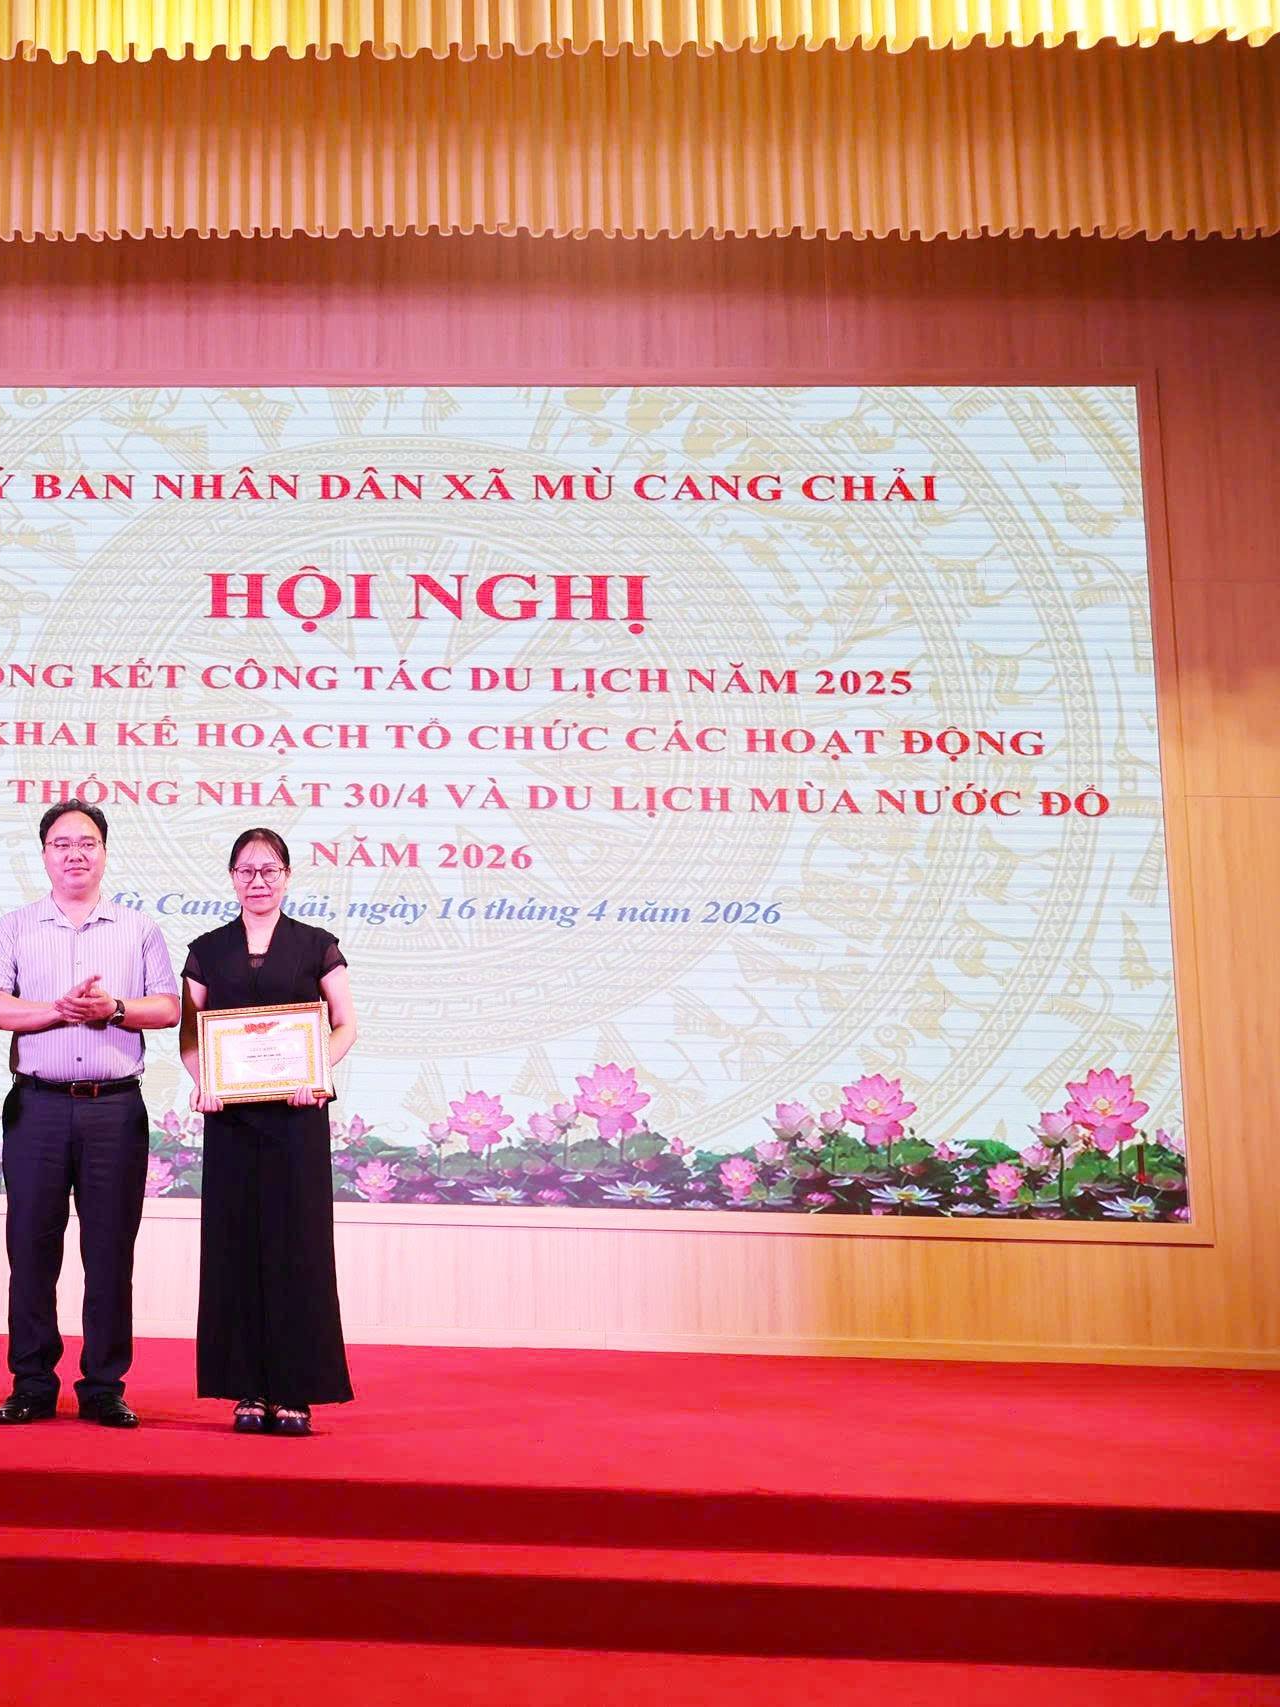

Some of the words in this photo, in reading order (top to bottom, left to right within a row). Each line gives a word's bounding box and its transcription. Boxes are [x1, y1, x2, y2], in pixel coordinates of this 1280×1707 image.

[34, 474, 132, 499] BAN
[154, 466, 299, 500] NHÂN
[320, 467, 424, 500] DÂN
[443, 468, 513, 500] XÃ
[533, 467, 613, 501] MÙ
[634, 474, 783, 501] CANG
[802, 467, 939, 502] CHẢI
[205, 566, 377, 632] HỘI
[406, 572, 652, 636] NGHỊ
[91, 656, 186, 688] KẾT
[202, 658, 337, 690] CÔNG
[354, 660, 451, 691] TÁC
[471, 668, 531, 691] DU
[552, 668, 669, 698] LỊCH
[687, 661, 798, 694] NĂM
[816, 670, 912, 695] 2025
[118, 716, 177, 746] KẾ
[196, 723, 369, 754] HOẠCH
[468, 719, 608, 750] CHỨC
[626, 720, 726, 752] CÁC
[746, 729, 884, 760] HOẠT
[901, 726, 1045, 762] ĐỘNG
[8, 773, 179, 805] THỐNG
[195, 775, 330, 807] NHẤT
[345, 784, 428, 808] 30/4
[446, 778, 509, 809] VÀ
[529, 786, 591, 810] DU
[612, 787, 731, 817] LỊCH
[750, 781, 862, 814] MÙA
[877, 783, 1021, 816] NƯỚC
[311, 837, 417, 867] NĂM
[439, 844, 532, 869] 2026
[156, 893, 241, 922] Cang
[280, 895, 336, 921] hải,
[348, 896, 426, 925] ngày
[440, 898, 475, 918] 16
[485, 898, 579, 928] tháng
[588, 900, 607, 921] 4
[618, 902, 690, 922] năm
[703, 902, 780, 924] 2026
